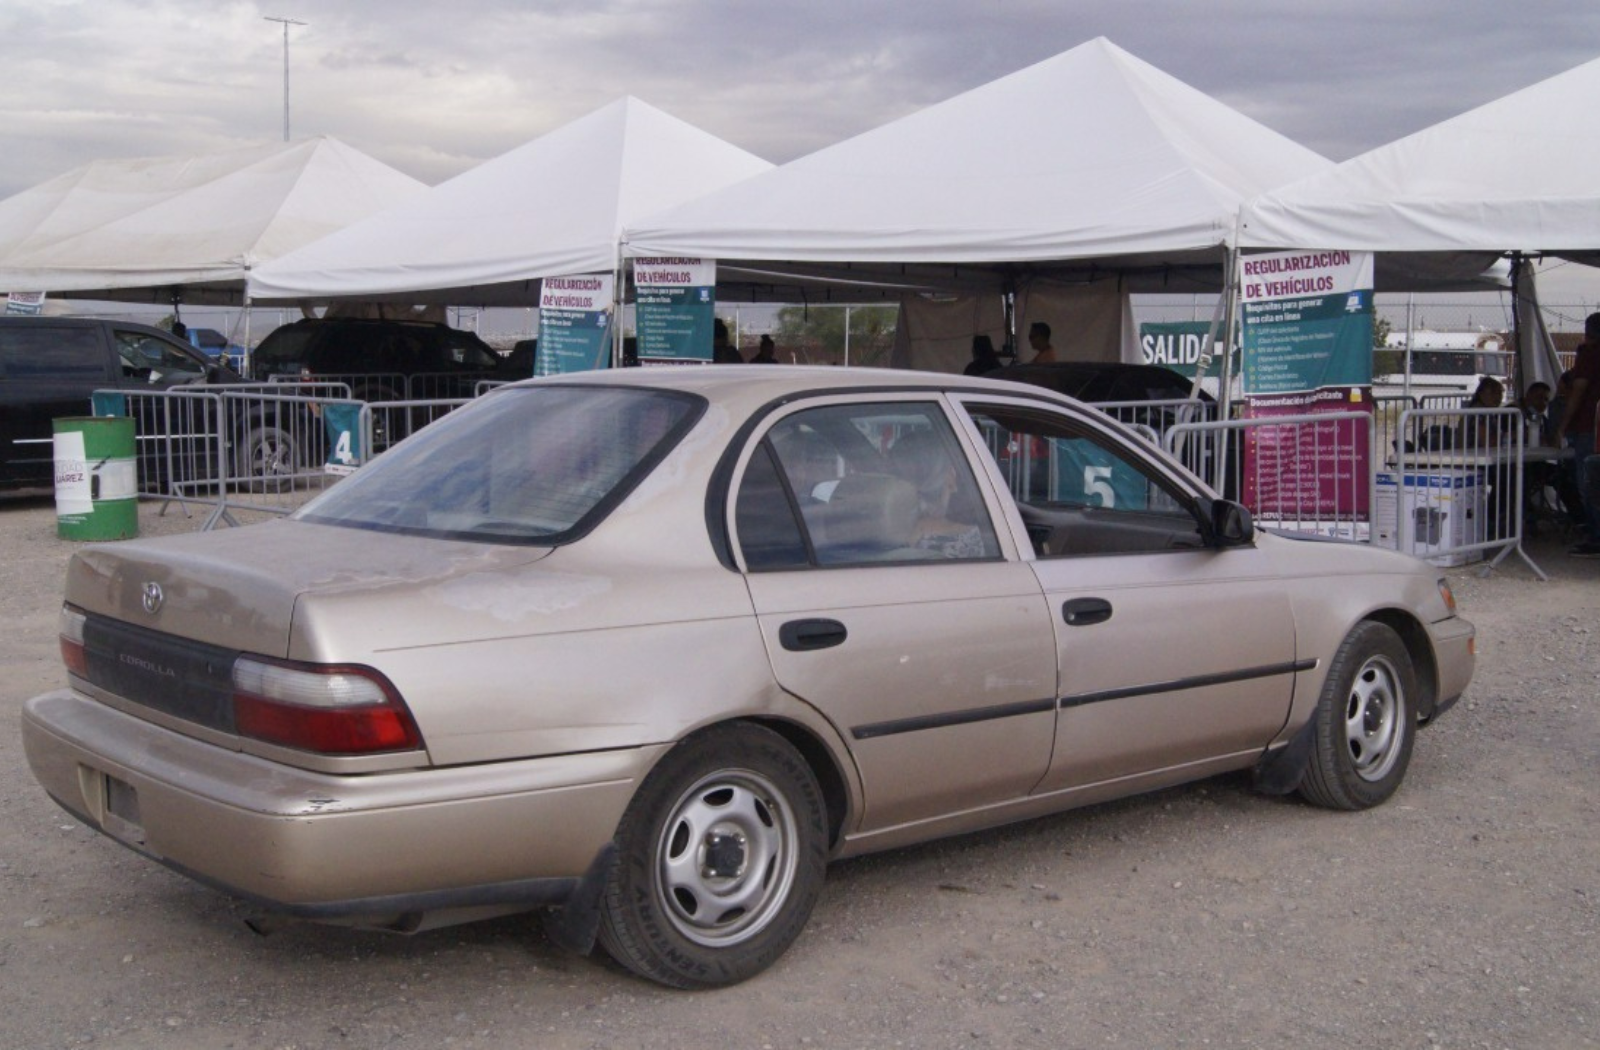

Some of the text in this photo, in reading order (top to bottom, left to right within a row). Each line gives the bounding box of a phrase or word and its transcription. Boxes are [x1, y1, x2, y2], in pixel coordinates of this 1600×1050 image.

[1245, 250, 1350, 275] REGULARIZACIÓN
[545, 277, 602, 291] REGULARIZACIÓN
[637, 269, 691, 283] DE VEHÍCULOS
[1246, 276, 1333, 298] DE VEHÍCULOS
[543, 294, 592, 307] DE VEHÍCULOS
[335, 430, 353, 464] 4
[1084, 465, 1115, 508] 5
[120, 653, 175, 678] COROLLA
